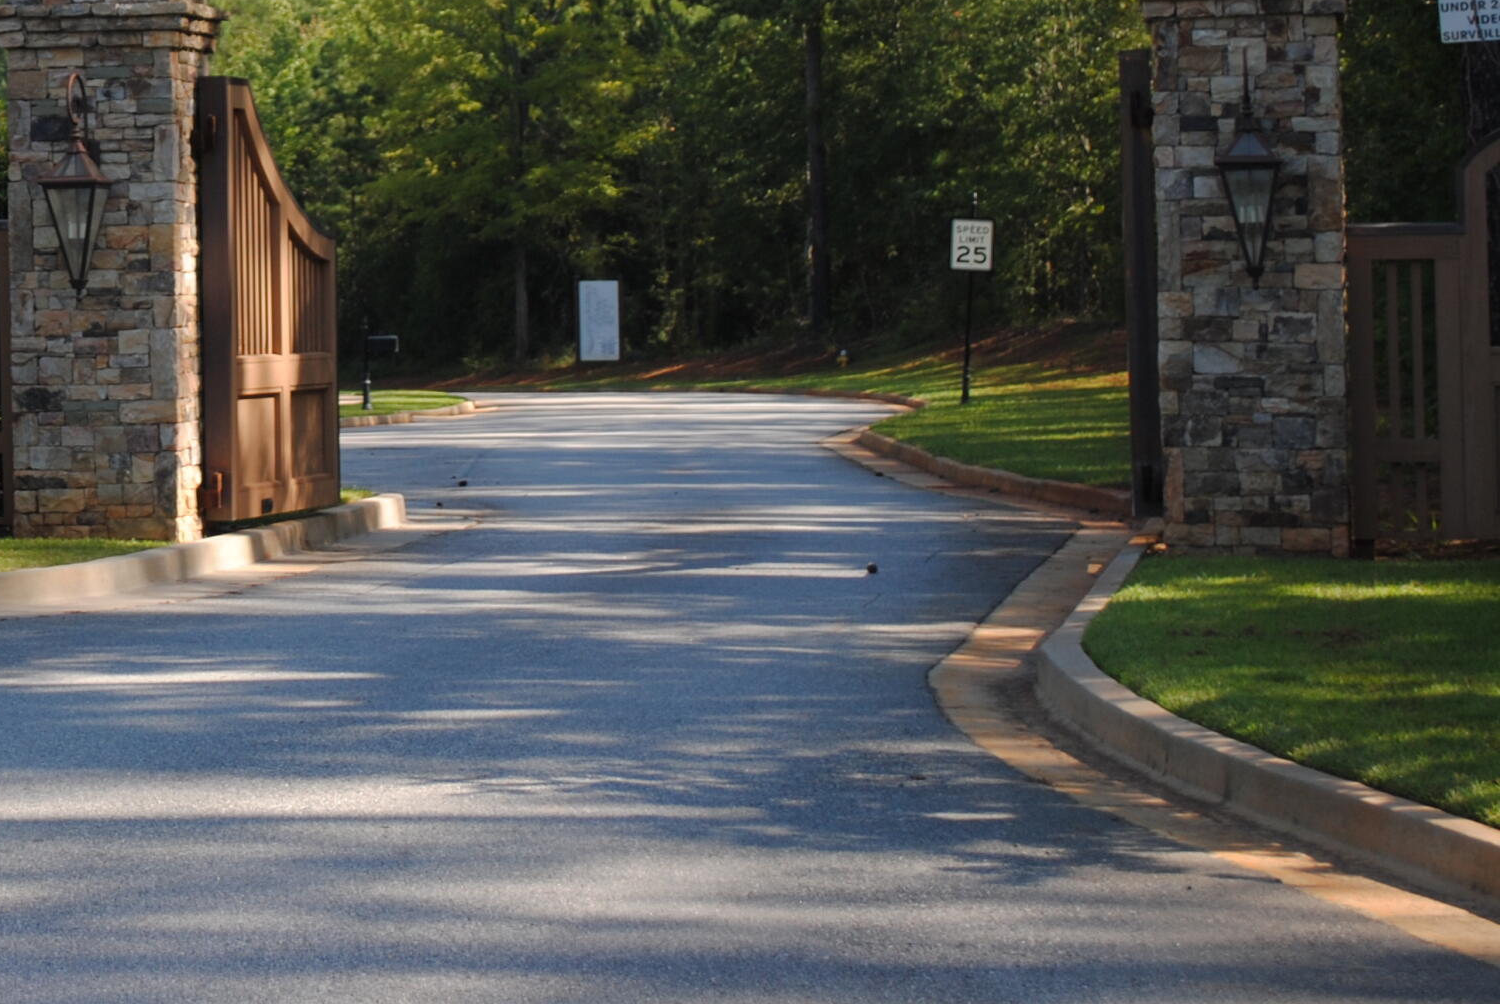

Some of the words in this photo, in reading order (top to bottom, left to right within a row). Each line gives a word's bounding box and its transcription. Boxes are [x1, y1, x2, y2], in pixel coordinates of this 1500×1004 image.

[1467, 13, 1500, 25] VIDE
[956, 225, 989, 234] SPEED
[959, 236, 984, 244] LIMIT
[956, 245, 987, 264] 25
